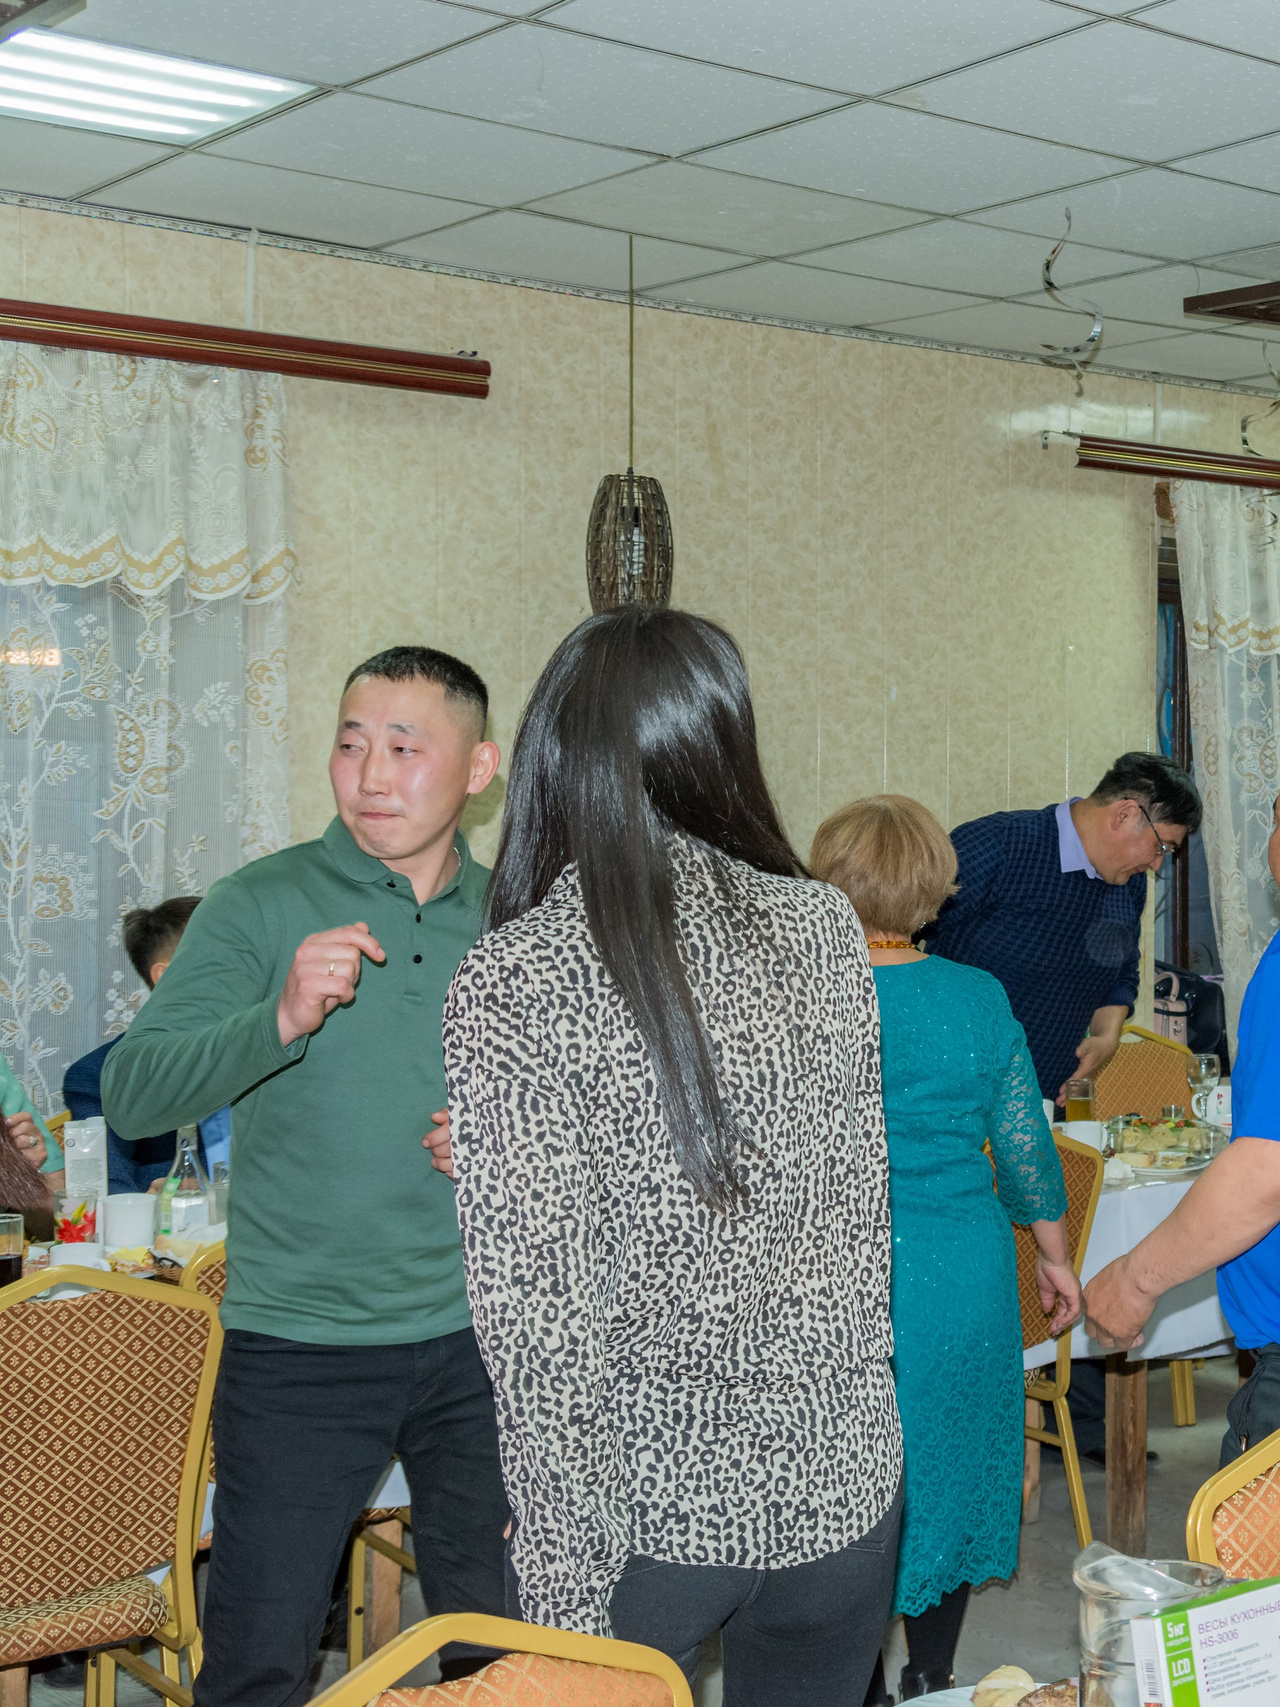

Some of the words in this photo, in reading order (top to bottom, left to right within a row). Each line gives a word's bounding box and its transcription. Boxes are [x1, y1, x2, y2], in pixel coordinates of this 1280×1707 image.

[1197, 1615, 1228, 1635] ВЕСЫ
[1199, 1628, 1240, 1650] HS-3006
[1171, 1657, 1192, 1677] LCD
